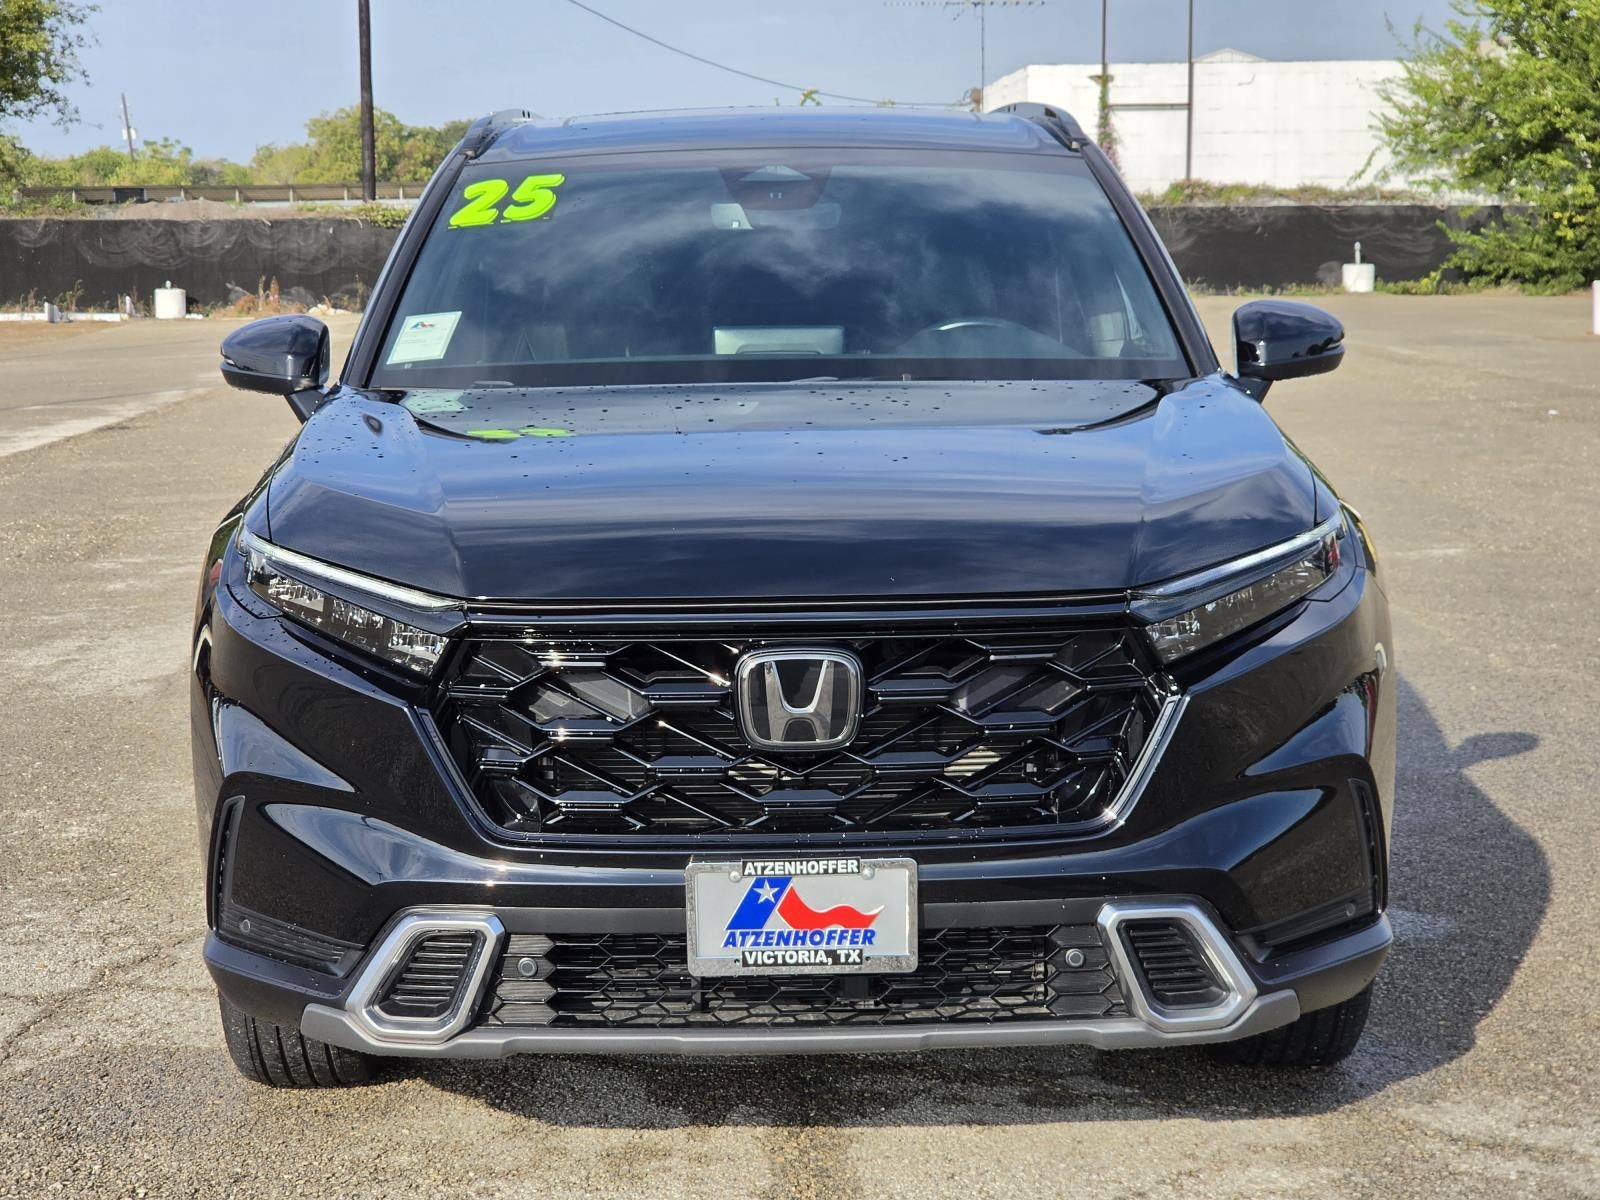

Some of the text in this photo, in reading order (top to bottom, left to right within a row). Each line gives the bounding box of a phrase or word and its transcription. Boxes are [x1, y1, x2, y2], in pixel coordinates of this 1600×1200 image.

[449, 173, 565, 228] 25
[744, 860, 859, 875] ATZENHOFFER
[723, 929, 876, 948] ATZENHOFFER
[745, 950, 861, 966] VICTORIA, TX
